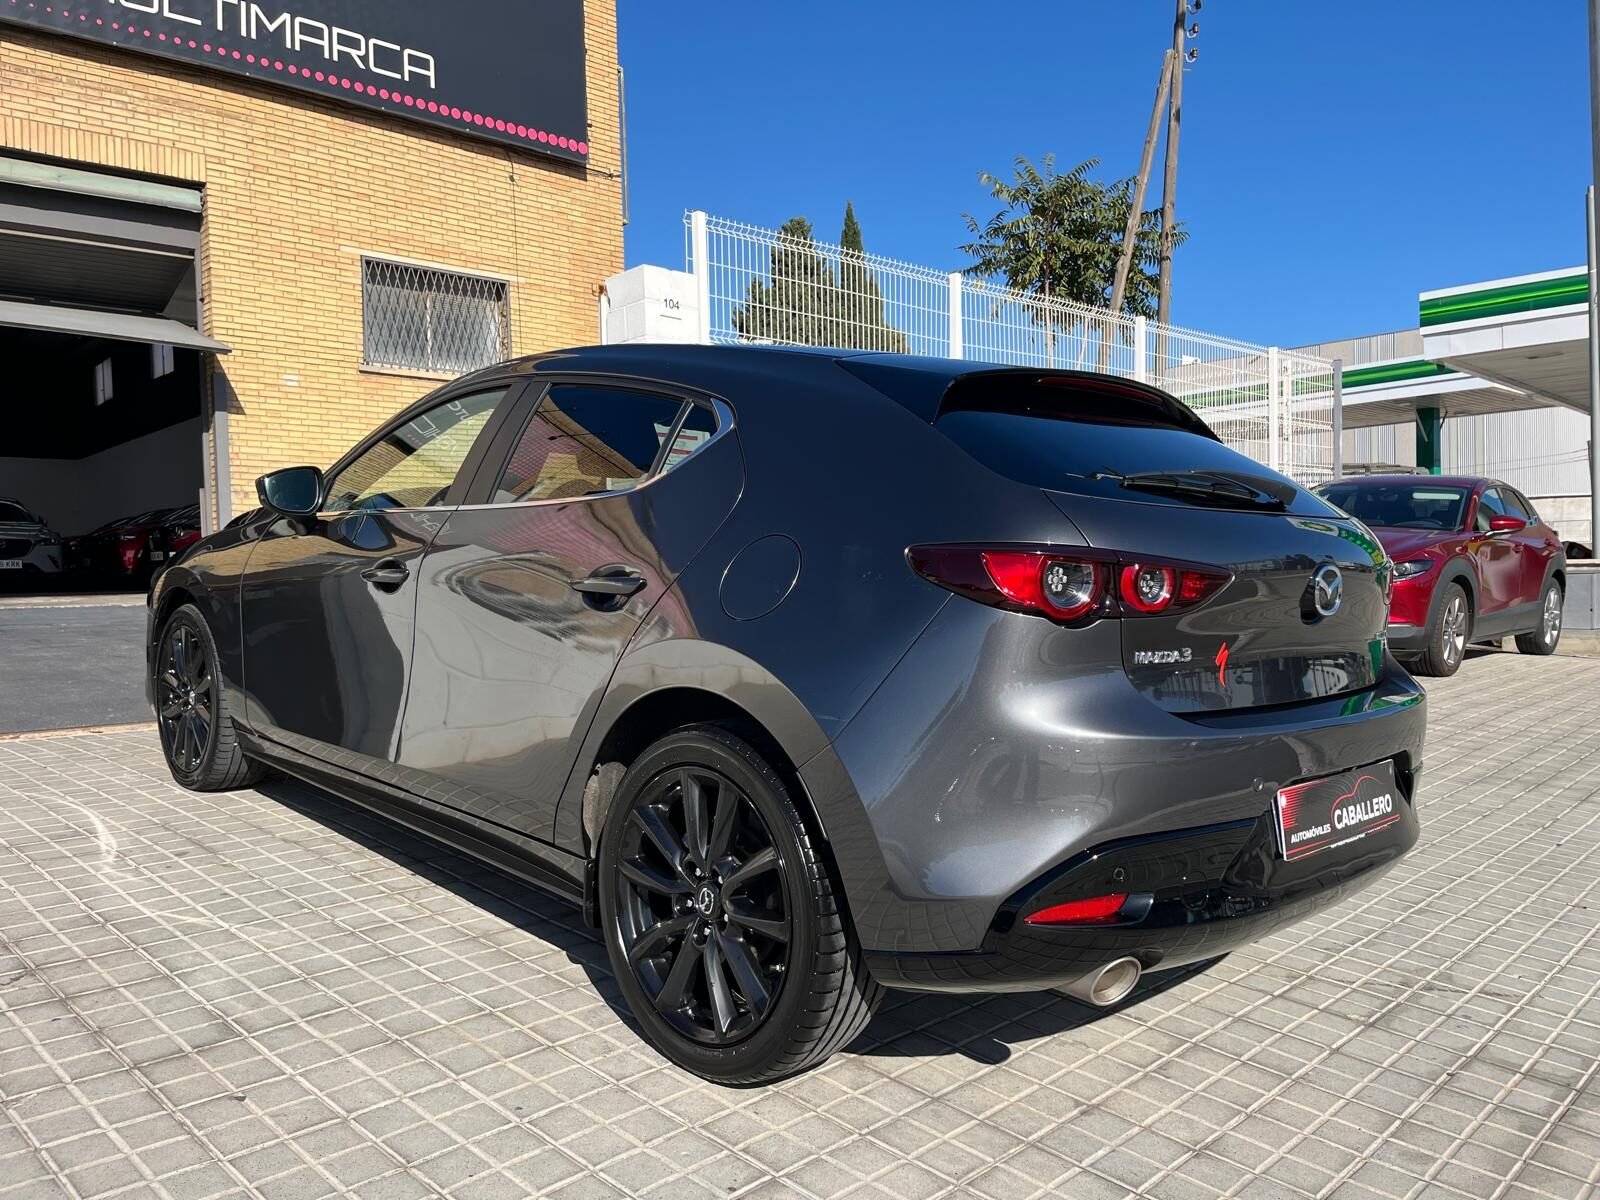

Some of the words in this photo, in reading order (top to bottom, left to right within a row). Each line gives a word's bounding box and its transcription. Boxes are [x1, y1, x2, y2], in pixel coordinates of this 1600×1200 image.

[663, 298, 680, 310] 104
[1290, 823, 1332, 844] AUTOMÓVILES
[1334, 794, 1393, 829] CABALLERO
